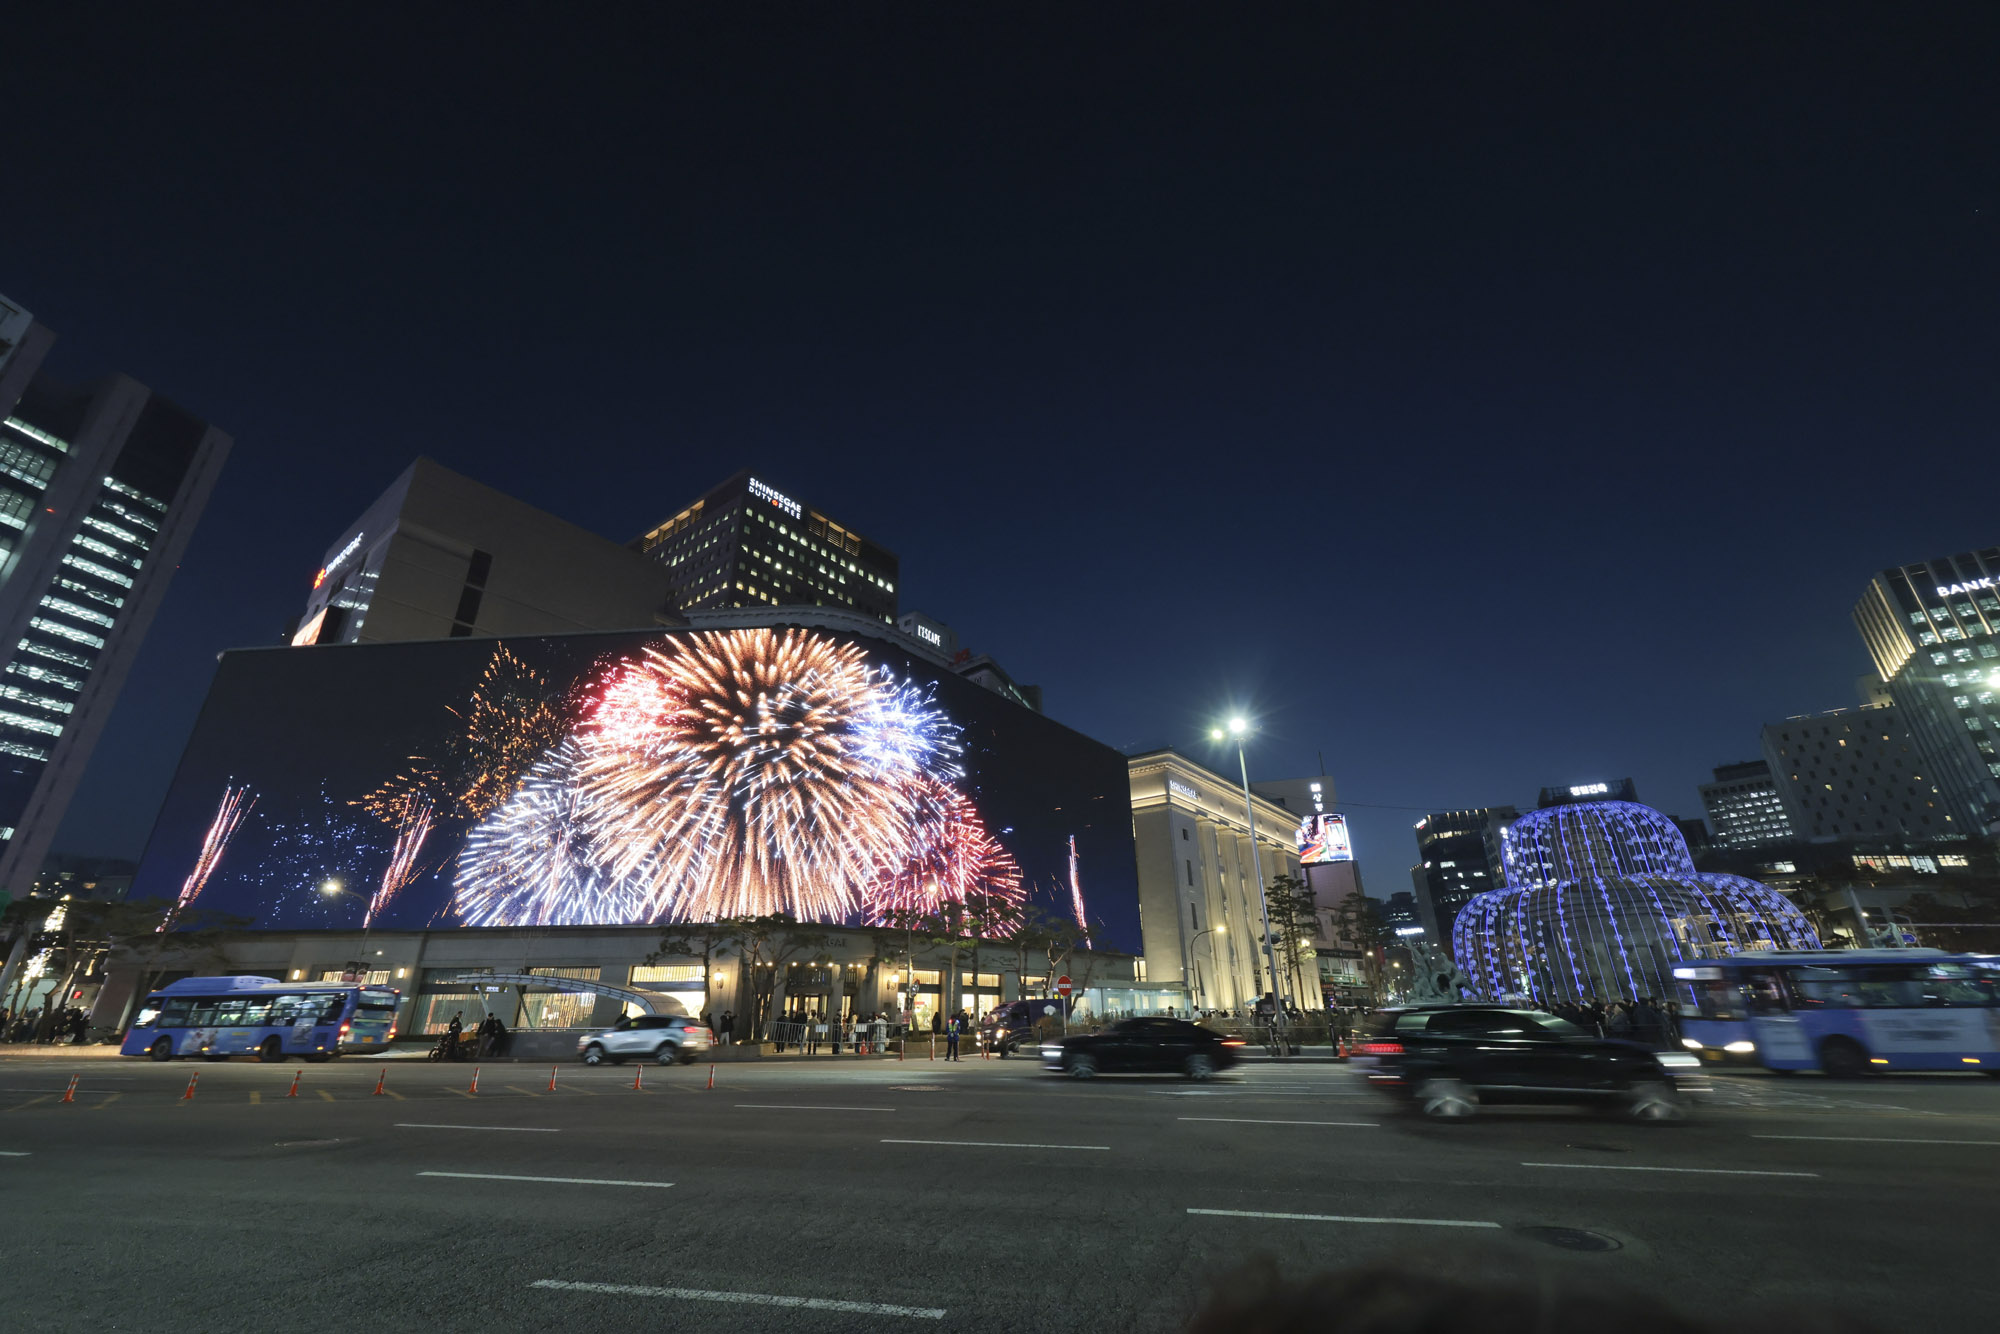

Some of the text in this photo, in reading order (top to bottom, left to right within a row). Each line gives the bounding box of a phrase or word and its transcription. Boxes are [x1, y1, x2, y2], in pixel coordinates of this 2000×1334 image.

[748, 485, 801, 520] DUTY FREE
[749, 477, 802, 513] SHINSEGAE
[1936, 577, 1996, 597] BANK
[917, 624, 941, 647] L'ESCAPE
